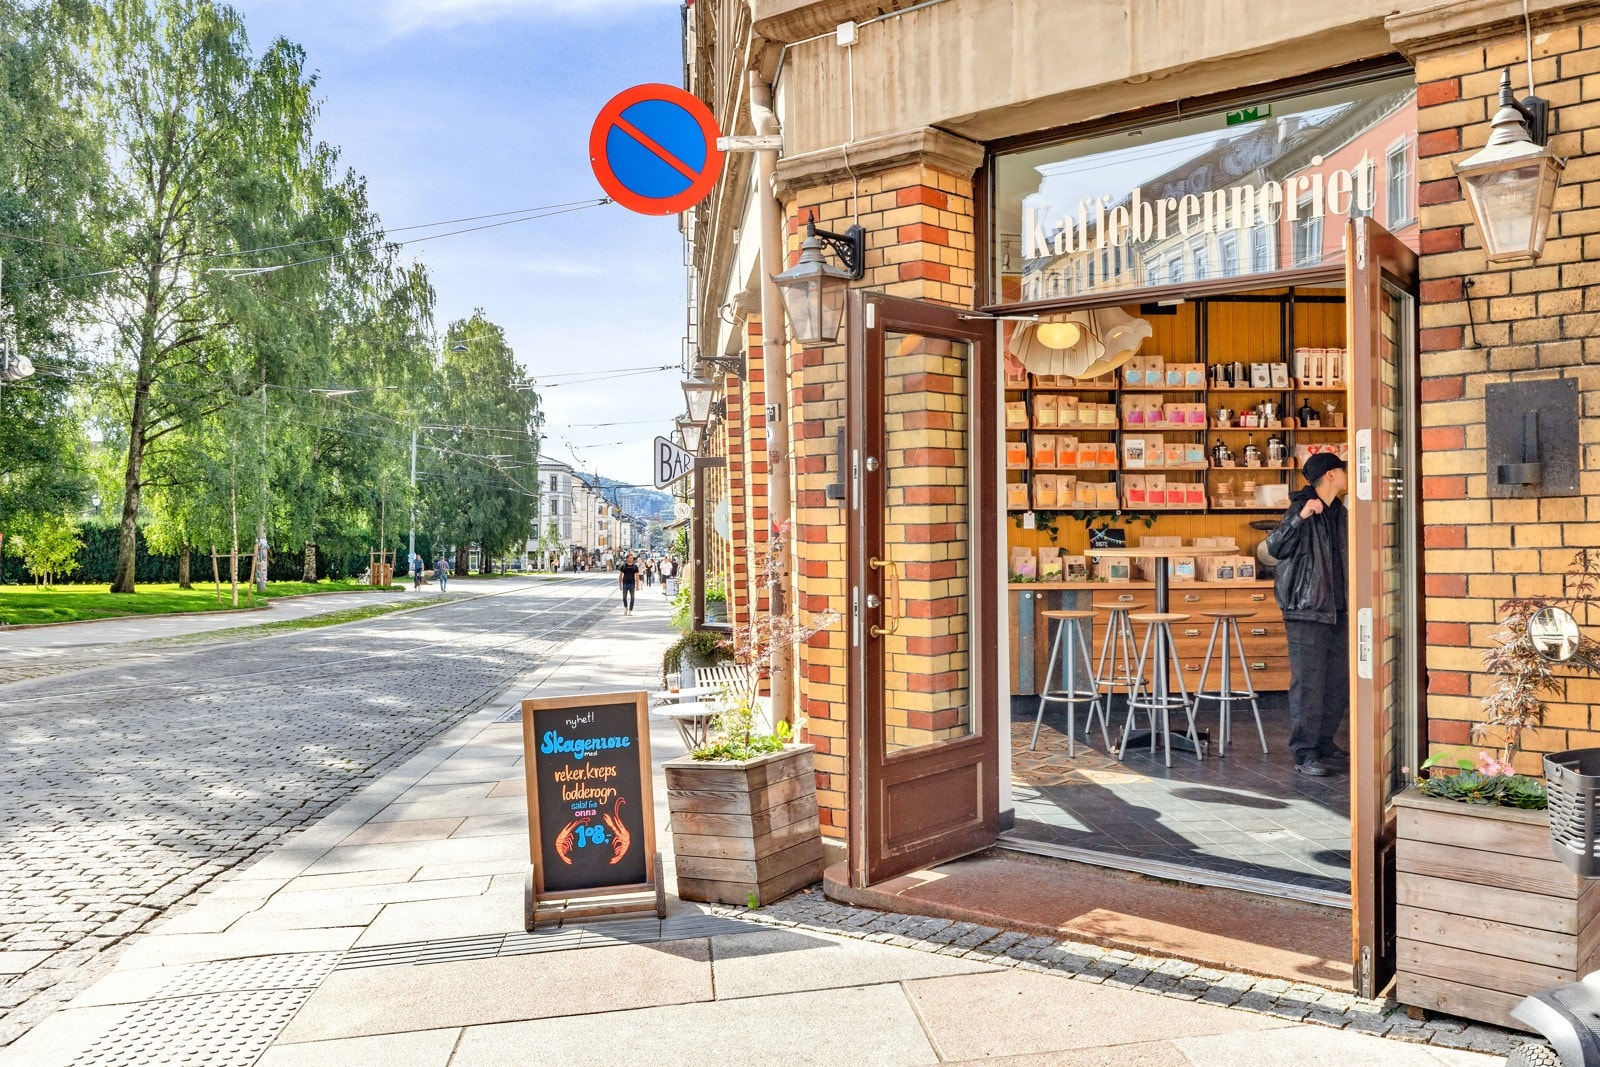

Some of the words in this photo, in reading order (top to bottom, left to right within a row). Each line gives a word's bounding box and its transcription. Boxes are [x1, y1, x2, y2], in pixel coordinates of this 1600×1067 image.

[1023, 149, 1377, 260] Kaffebrenneriet
[660, 442, 691, 483] BAR
[565, 711, 595, 729] nyhet!
[562, 782, 617, 805] lodderogn
[574, 809, 597, 817] onna
